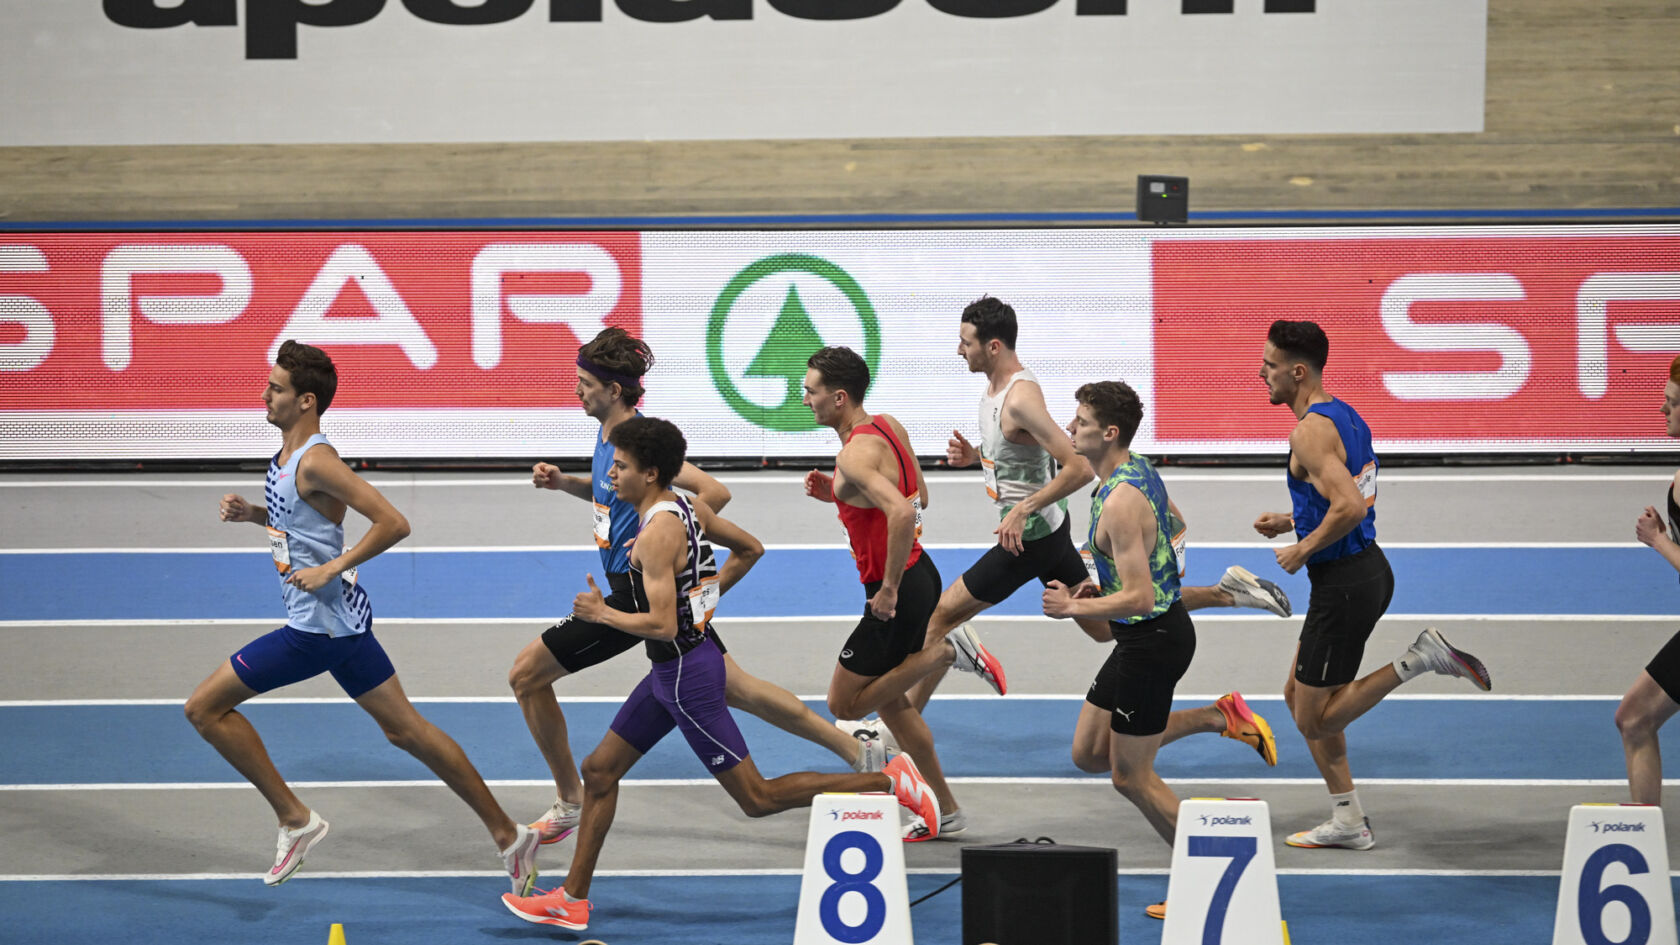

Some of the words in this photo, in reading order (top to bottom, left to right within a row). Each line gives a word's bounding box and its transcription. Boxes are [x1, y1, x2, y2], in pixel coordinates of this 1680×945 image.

[841, 809, 884, 822] polanik
[1211, 815, 1253, 827] polanik
[1602, 821, 1647, 834] polanik
[819, 830, 887, 945] 8
[1187, 835, 1258, 945] 7
[1577, 843, 1652, 945] 6
